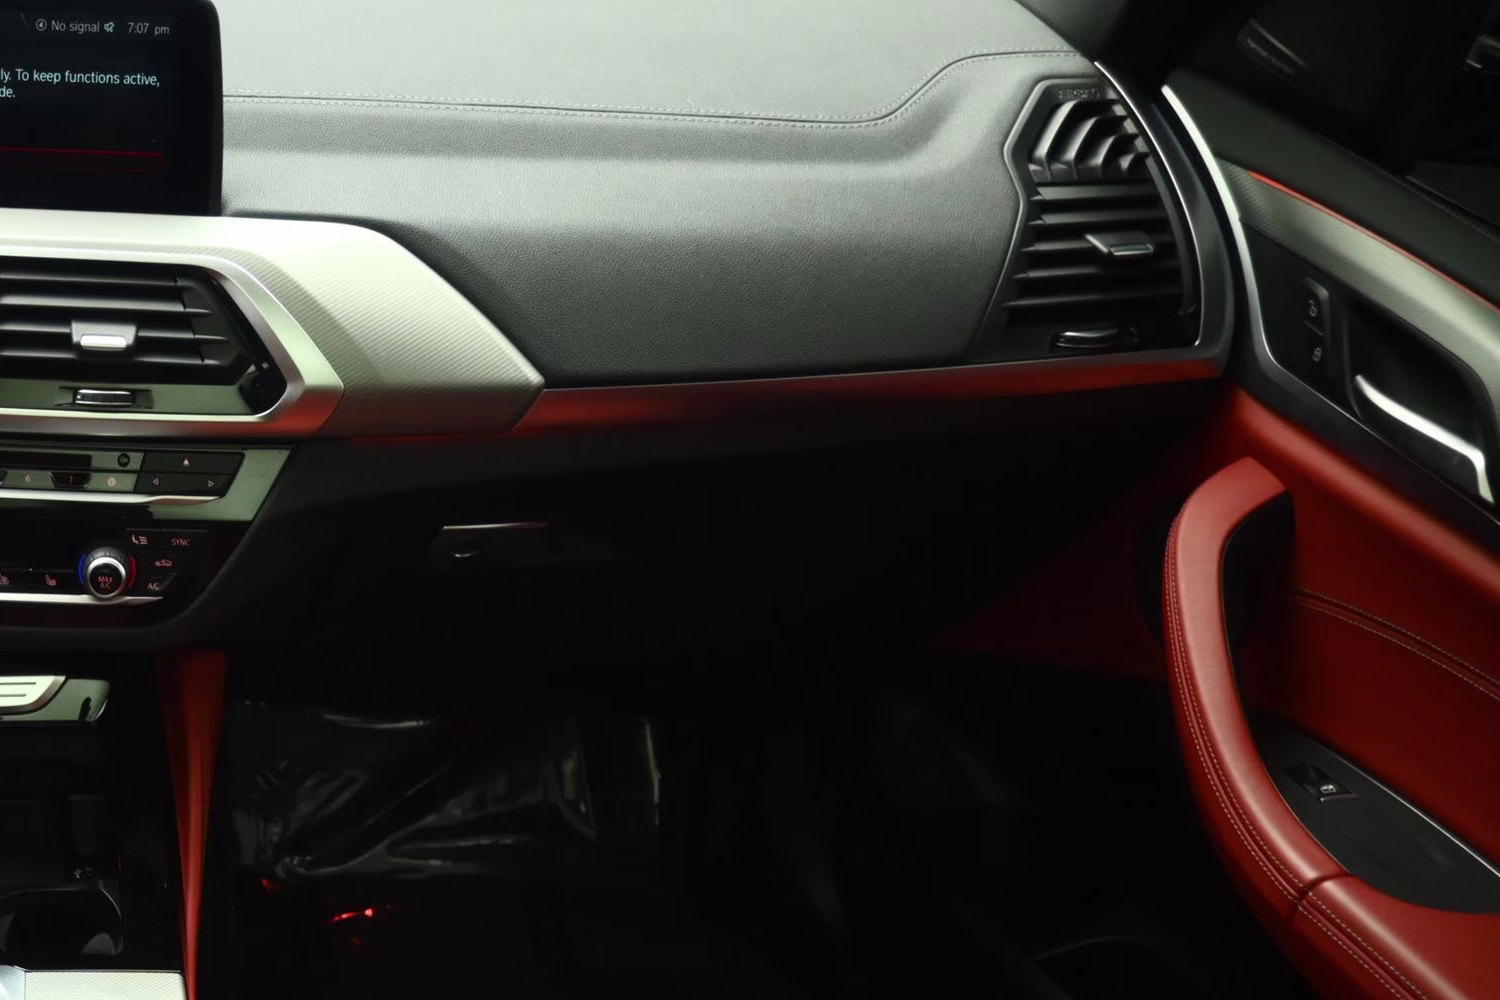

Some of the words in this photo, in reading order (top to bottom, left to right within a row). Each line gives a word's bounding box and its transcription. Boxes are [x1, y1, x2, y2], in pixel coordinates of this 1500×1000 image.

[51, 20, 66, 32] No
[69, 21, 100, 34] signal
[128, 22, 149, 34] 7:07
[154, 25, 170, 36] pm
[15, 68, 30, 81] To
[33, 69, 61, 84] keep
[65, 70, 120, 85] functions
[123, 72, 160, 88] active,
[171, 538, 191, 546] SYNC
[147, 582, 161, 591] A/C
